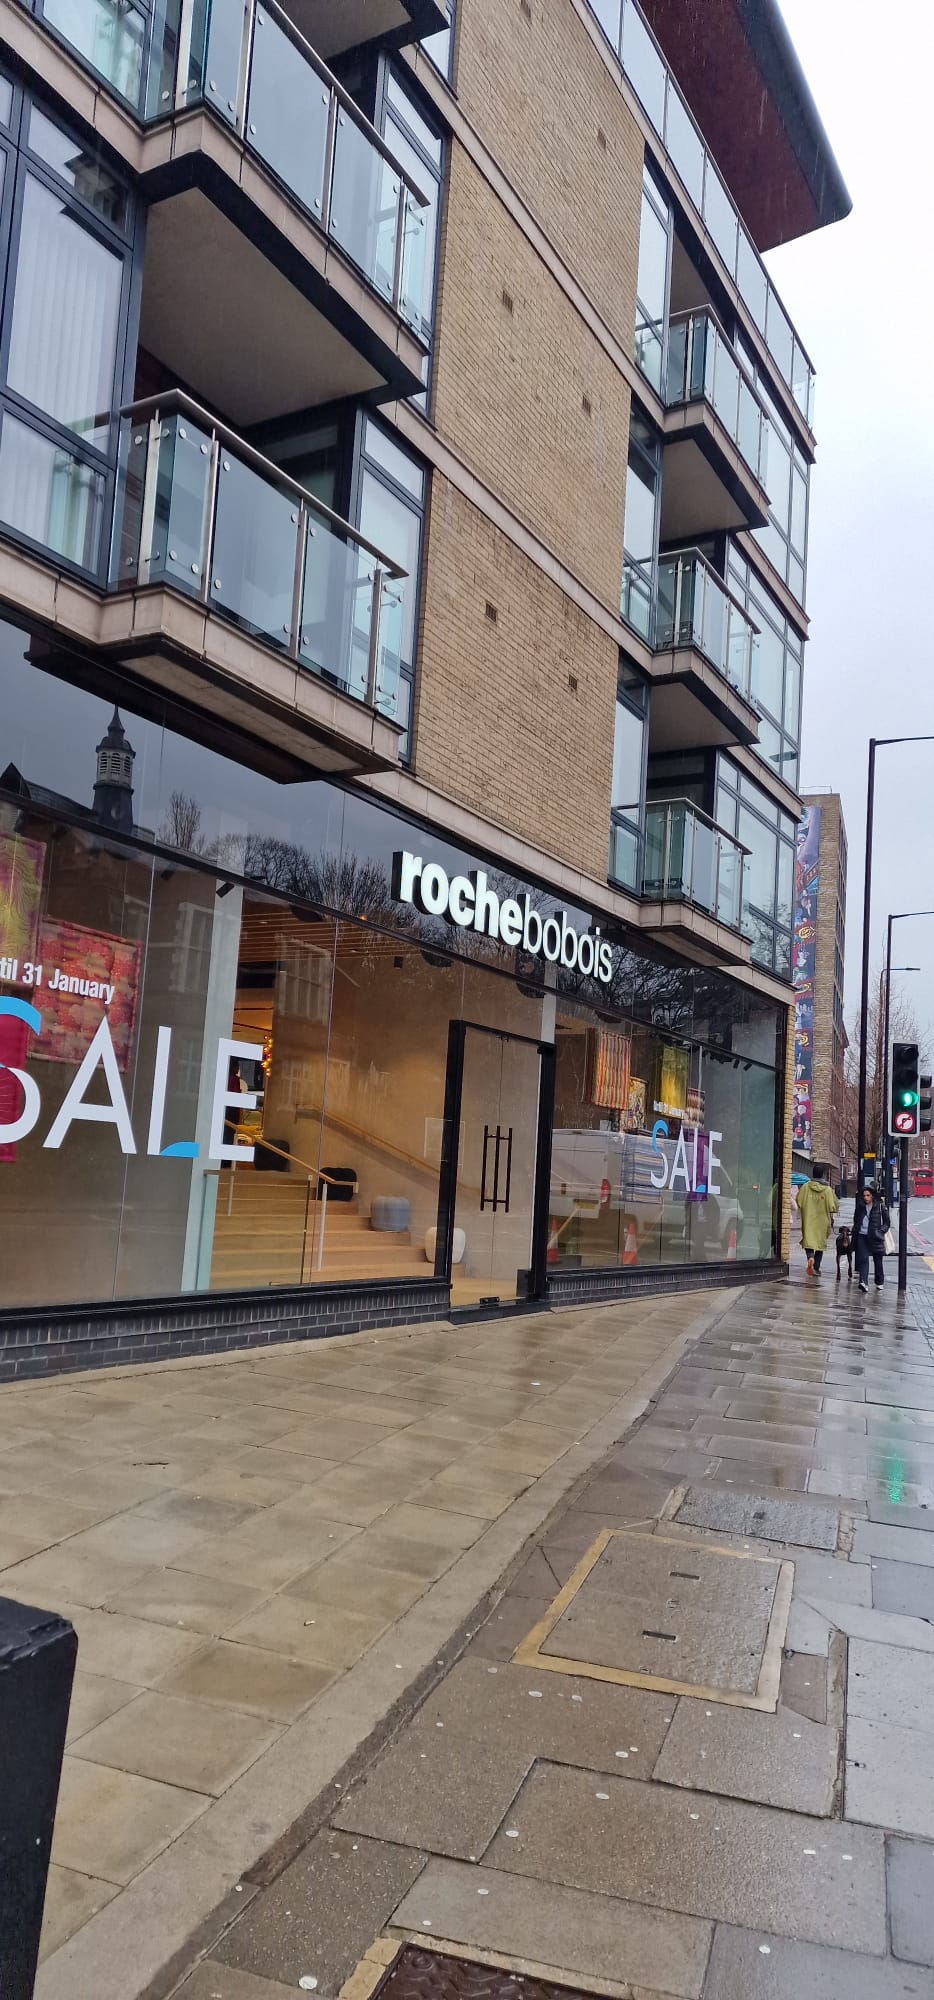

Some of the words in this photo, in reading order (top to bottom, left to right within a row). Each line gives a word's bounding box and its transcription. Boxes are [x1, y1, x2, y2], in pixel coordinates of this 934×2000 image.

[397, 850, 613, 983] rochebobois
[22, 962, 43, 986] 31
[48, 968, 115, 1005] January
[650, 1119, 723, 1195] SALE
